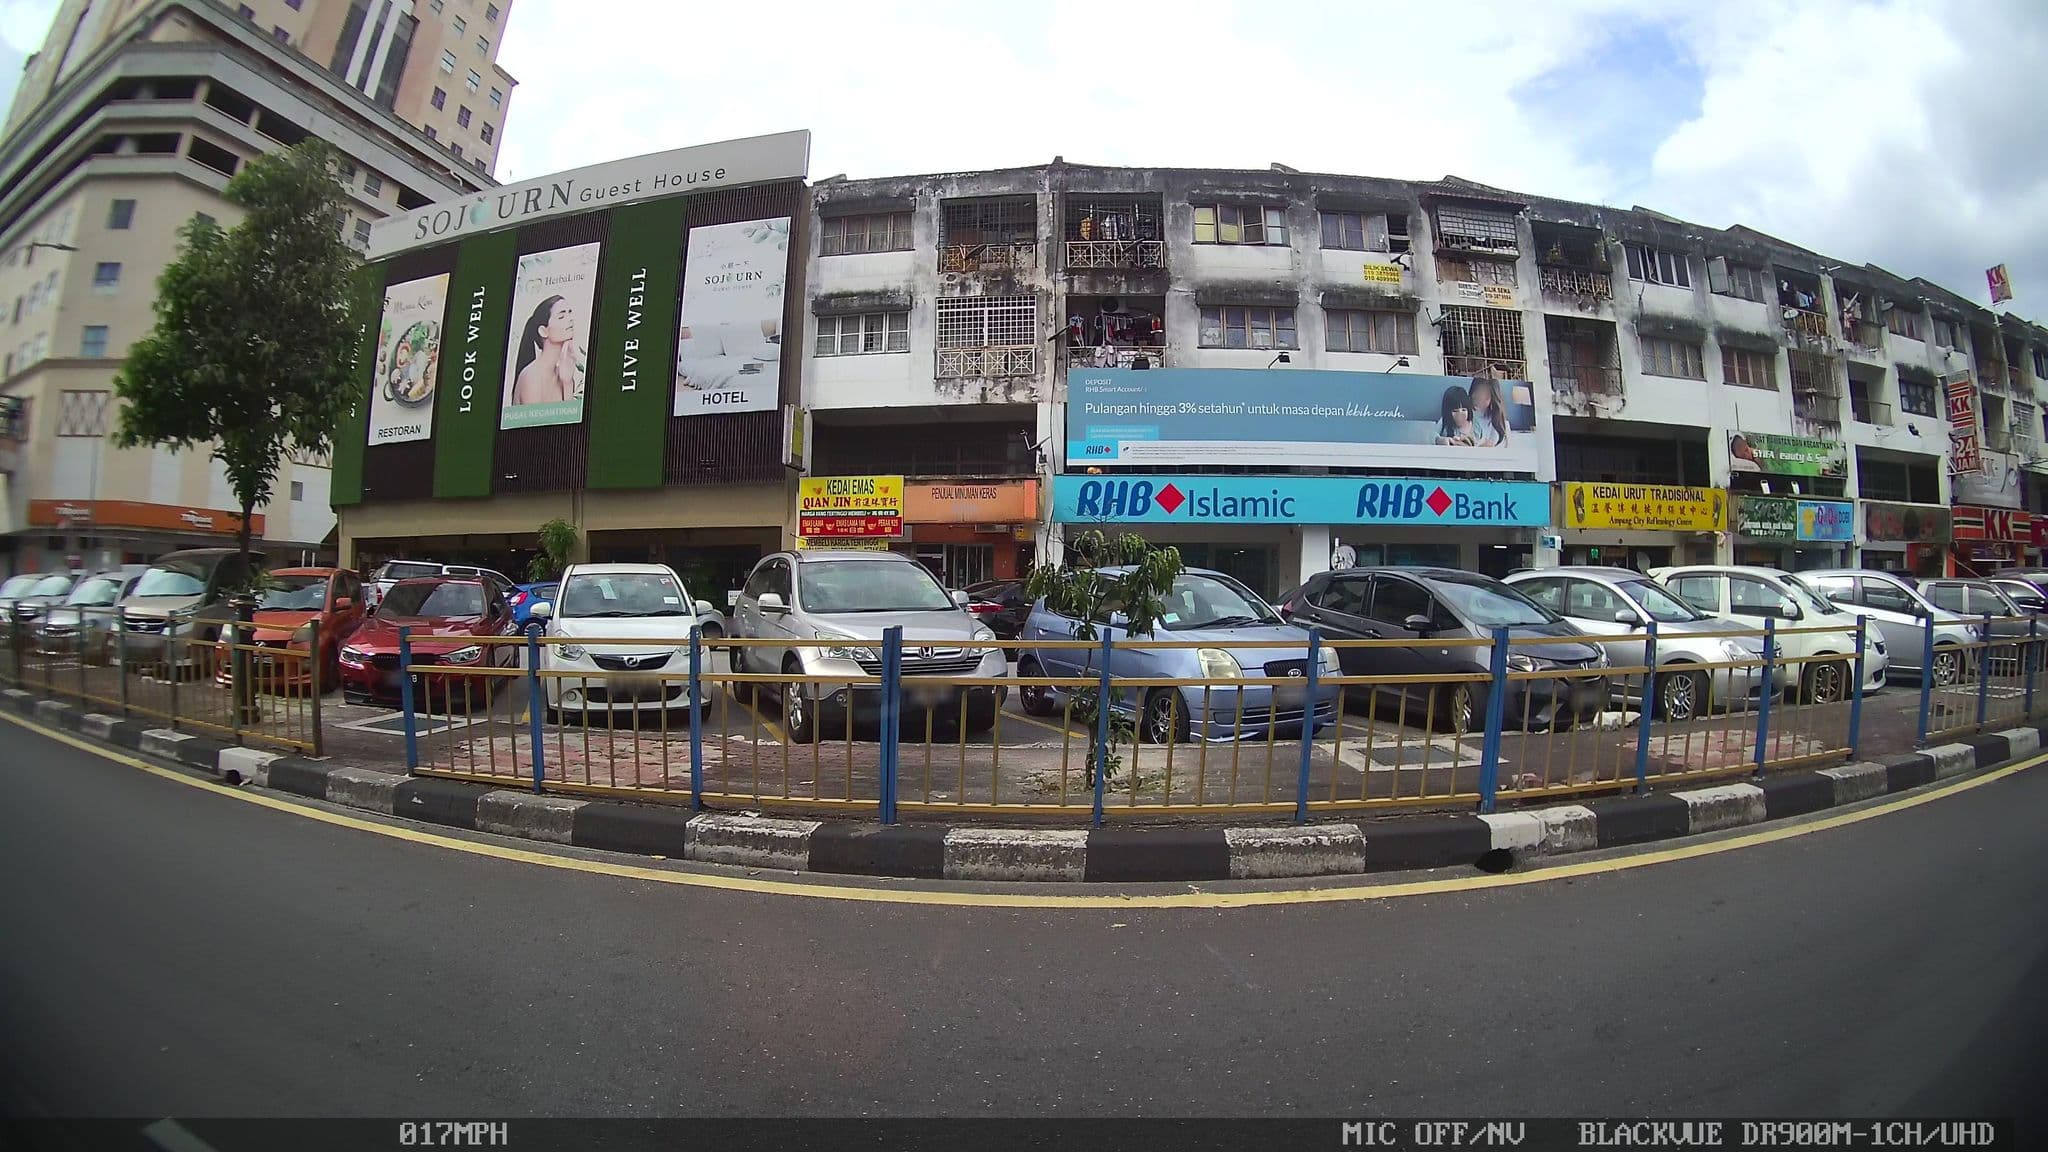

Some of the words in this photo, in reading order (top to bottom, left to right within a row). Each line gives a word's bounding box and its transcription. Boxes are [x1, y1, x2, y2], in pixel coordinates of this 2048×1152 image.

[579, 178, 642, 202] Guest
[654, 167, 726, 190] House
[627, 267, 647, 330] WELL
[467, 286, 486, 343] WELL
[621, 338, 639, 392] LIVE
[459, 350, 477, 413] LOOK
[702, 391, 748, 405] HOTEL
[1951, 396, 1970, 414] KK
[1085, 402, 1138, 416] Pulangan
[1139, 402, 1177, 416] hingga
[1178, 402, 1197, 414] 3%
[1247, 403, 1280, 415] untuk
[1281, 406, 1310, 416] masa
[1312, 404, 1344, 418] depan
[377, 424, 421, 438] RESTORAN
[1086, 445, 1104, 455] RHB
[1956, 437, 1975, 457] 24
[826, 479, 850, 495] KEDAI
[852, 478, 875, 495] EMAS
[979, 487, 997, 499] KERAS
[1592, 486, 1621, 499] KEDAI
[1624, 486, 1646, 500] URUT
[1649, 487, 1705, 502] TRADISIONAL
[803, 496, 830, 509] QIAN
[833, 496, 851, 508] JIN
[1076, 480, 1154, 517] RHB
[1188, 487, 1296, 518] Islamic
[1356, 483, 1425, 519] RHB
[1455, 492, 1518, 520] Bank
[1609, 516, 1634, 526] Ampang
[1634, 516, 1645, 526] City
[1984, 509, 2013, 541] KK
